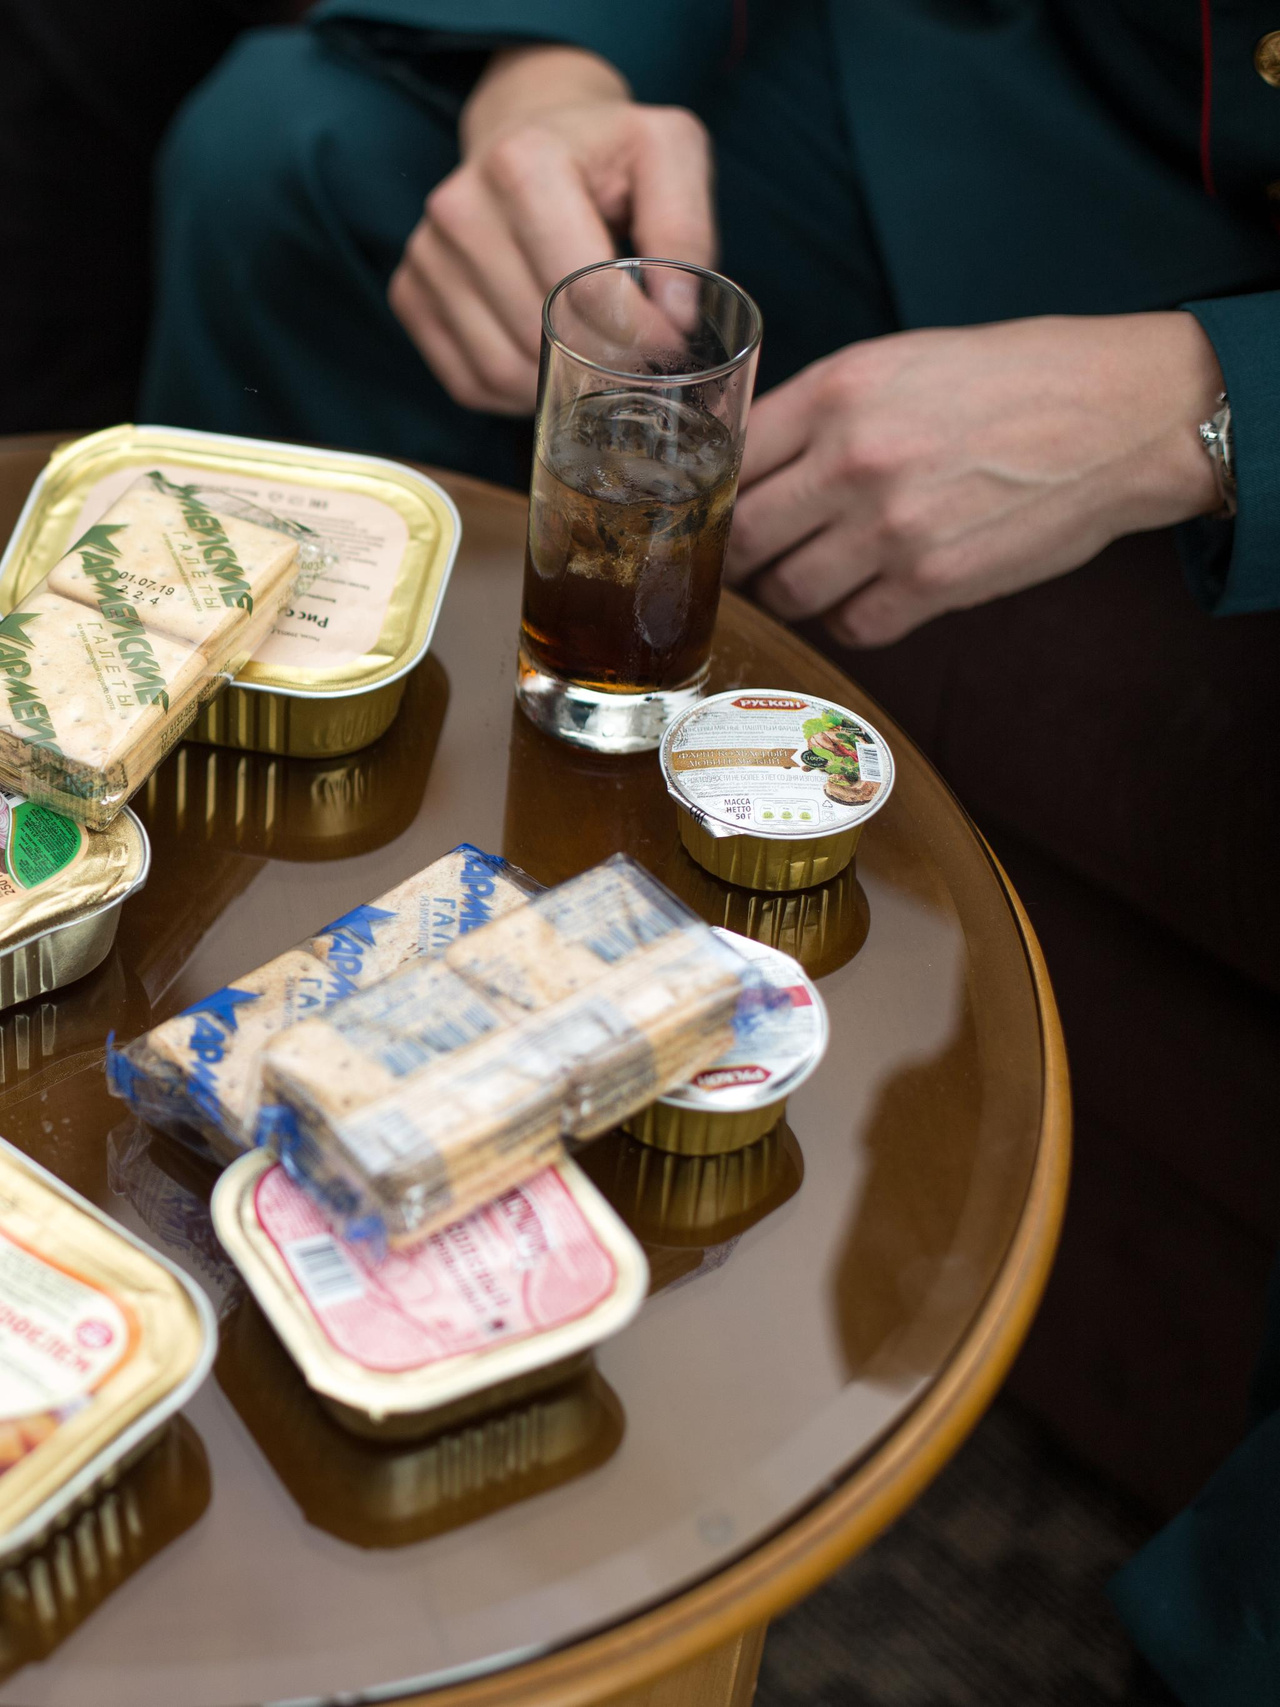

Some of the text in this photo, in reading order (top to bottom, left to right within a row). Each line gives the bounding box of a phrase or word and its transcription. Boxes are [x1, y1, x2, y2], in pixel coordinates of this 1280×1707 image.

[173, 530, 221, 610] ГАЛЕТЫ
[119, 571, 175, 597] 01.07.19
[298, 611, 329, 629] Рис
[78, 551, 169, 714] АРМЕЙСКИЕ
[87, 622, 135, 707] ГАЛЕТЫ
[104, 693, 116, 711] сорта
[740, 700, 801, 708] РУСКОН
[724, 798, 751, 806] МАССА
